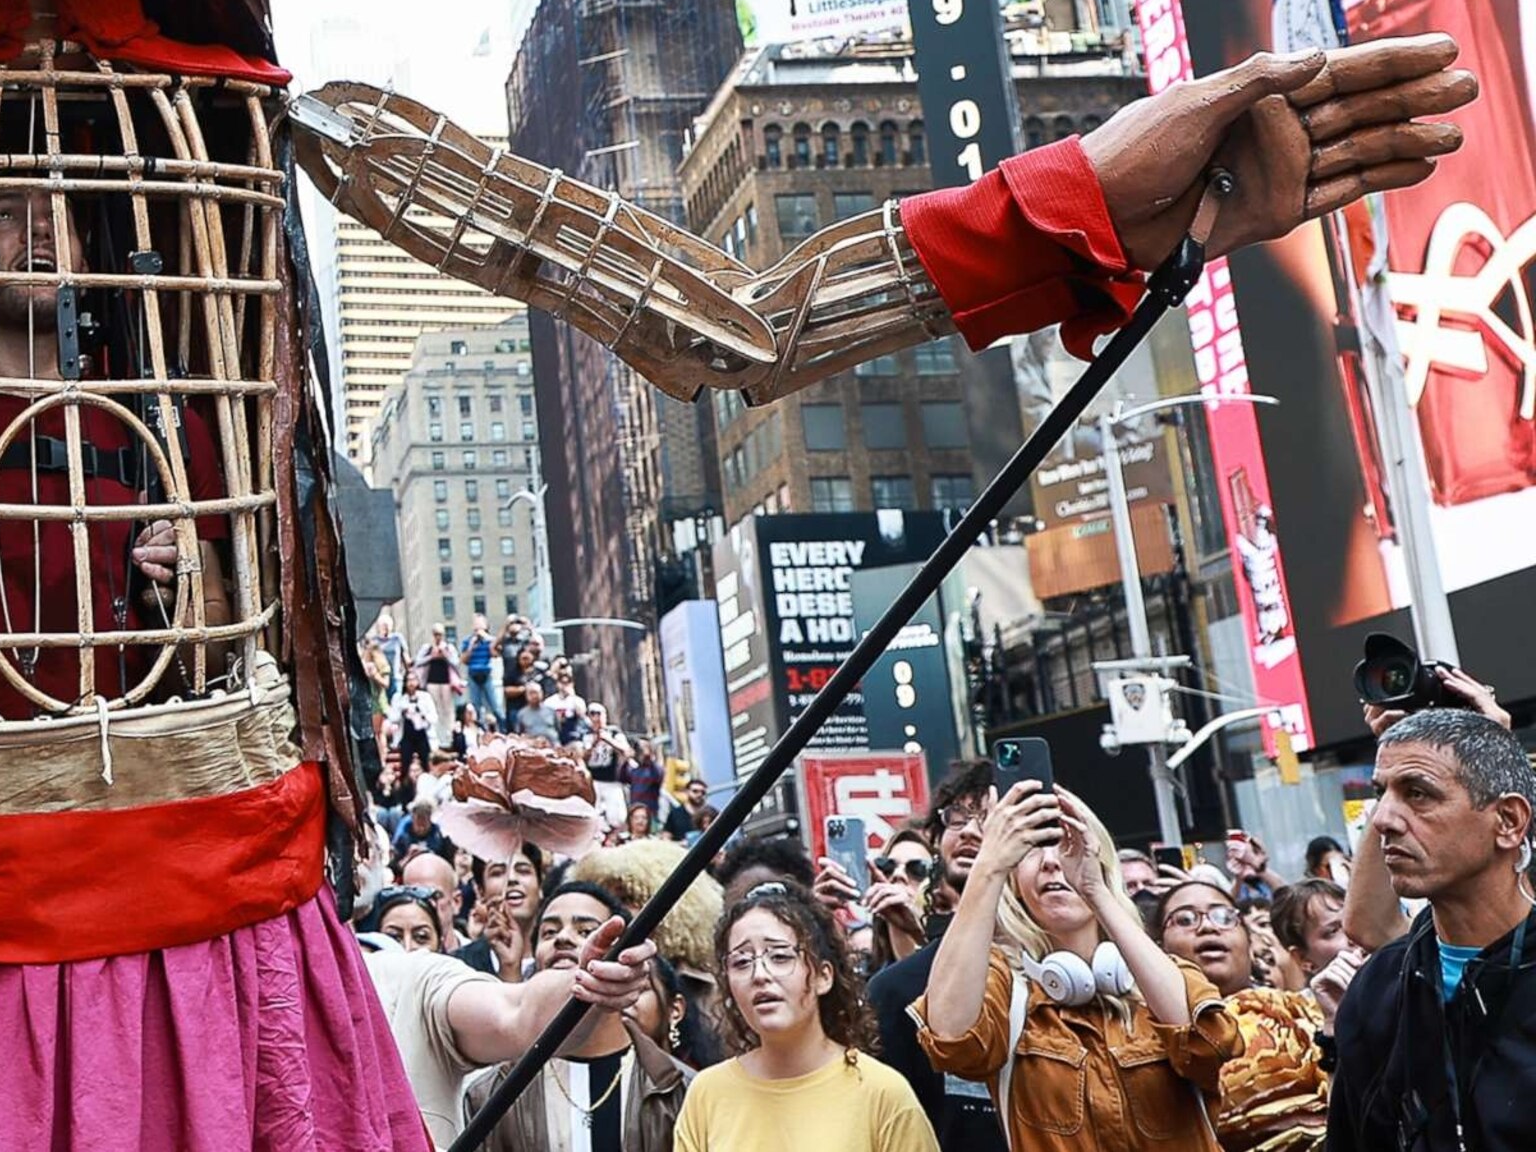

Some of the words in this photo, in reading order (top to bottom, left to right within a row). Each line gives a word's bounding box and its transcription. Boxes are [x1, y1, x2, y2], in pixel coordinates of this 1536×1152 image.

[770, 541, 866, 566] EVERY
[776, 592, 854, 617] DESE
[780, 619, 804, 643] A
